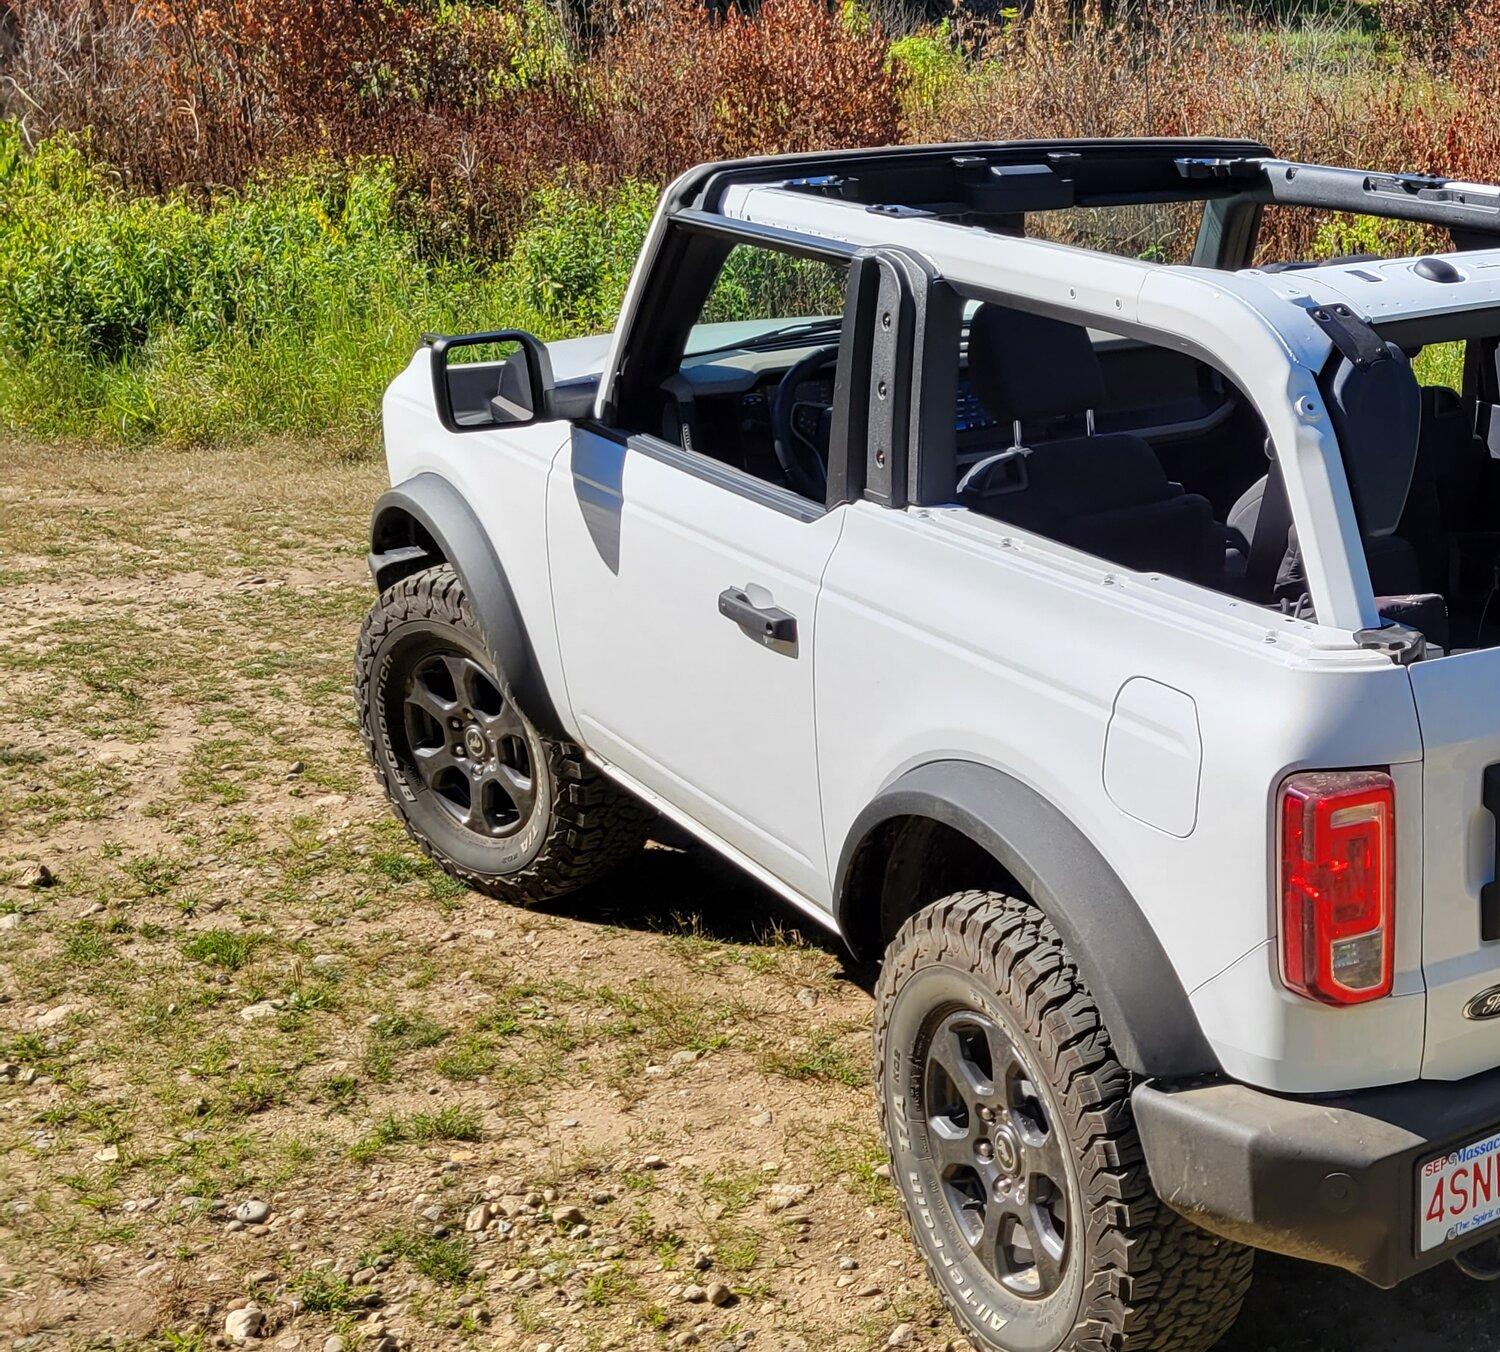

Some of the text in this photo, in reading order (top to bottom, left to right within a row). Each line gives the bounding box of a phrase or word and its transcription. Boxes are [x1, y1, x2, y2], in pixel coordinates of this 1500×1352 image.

[375, 653, 417, 802] BFGoodrich
[892, 1092, 911, 1152] T/A
[1425, 1155, 1449, 1177] SEP
[1471, 1208, 1494, 1225] Spirit
[908, 1171, 1008, 1331] All-Terrain
